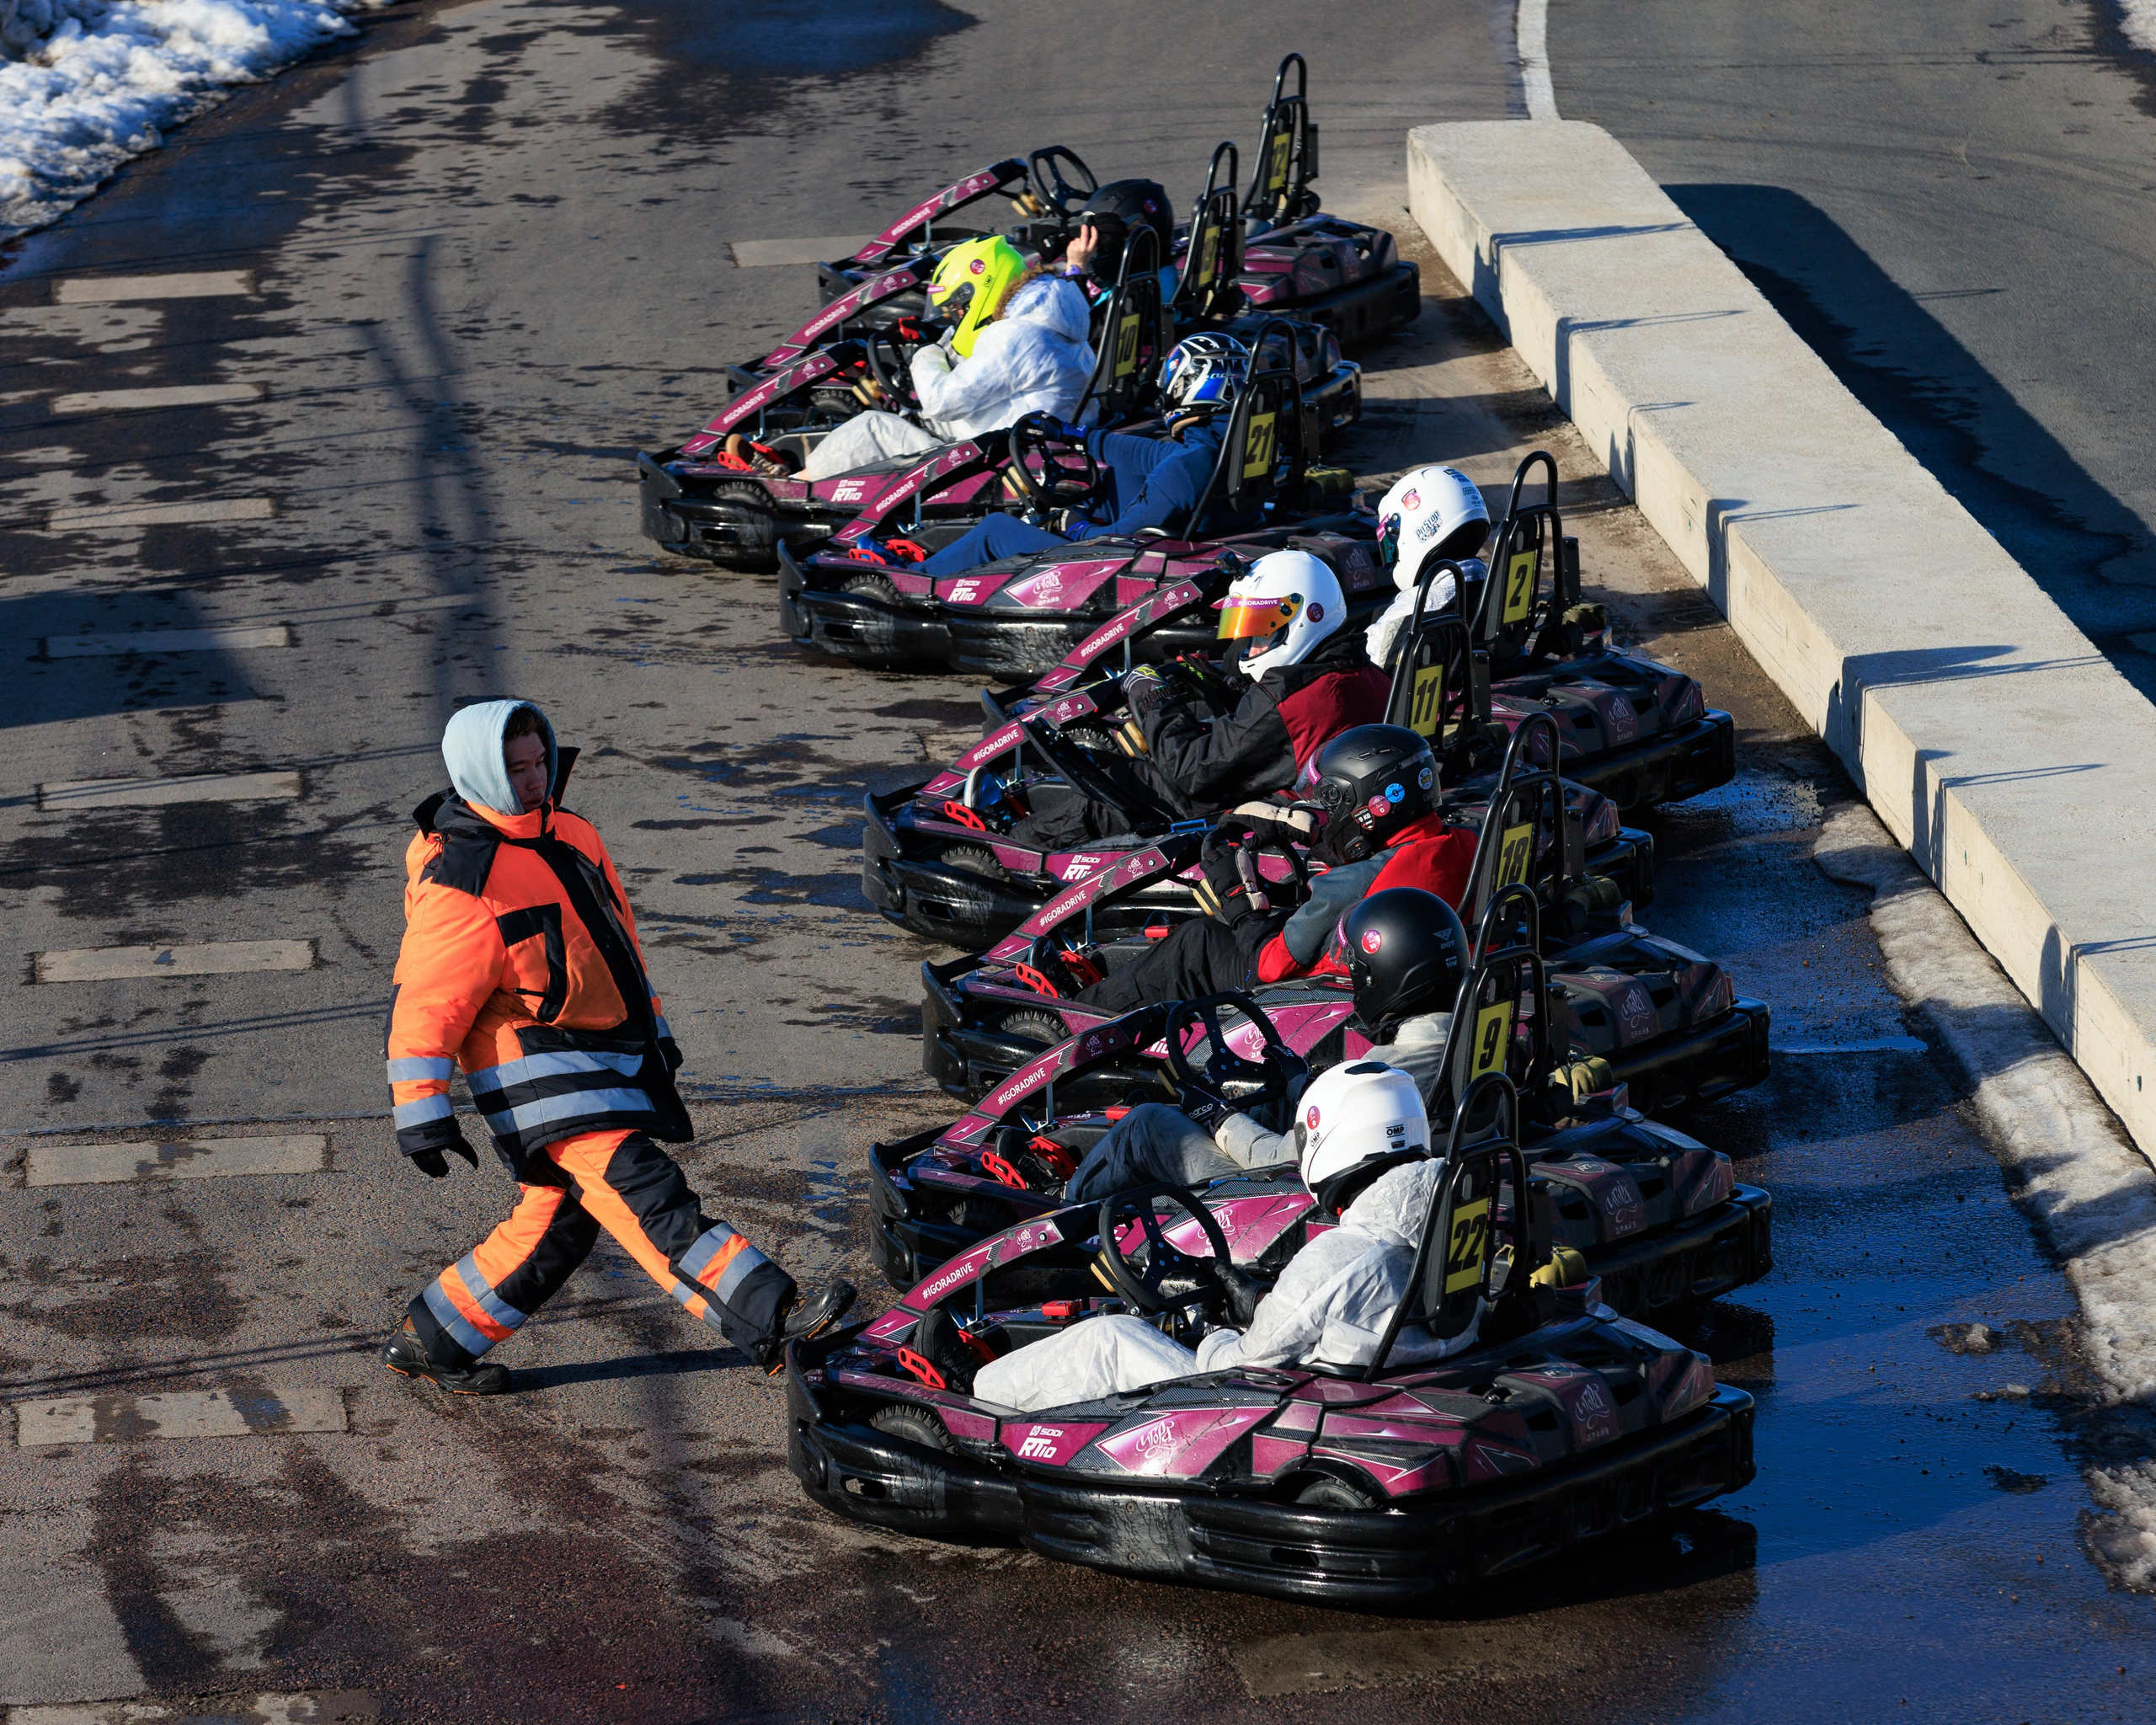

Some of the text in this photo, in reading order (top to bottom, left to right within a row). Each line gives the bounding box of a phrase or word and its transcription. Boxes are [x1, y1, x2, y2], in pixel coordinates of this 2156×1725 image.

[1117, 324, 1138, 364] 10
[1245, 422, 1273, 465] 21
[876, 479, 915, 512] #IGORADRIVE
[1508, 563, 1529, 608] 2
[1080, 622, 1125, 657] #IGORADRIVE
[1413, 676, 1438, 724] 11
[972, 729, 1019, 762] #IGORADRIVE
[1499, 836, 1529, 888] 18
[1039, 890, 1086, 927] #IGORADRIVE
[1440, 940, 1455, 949] DOT
[1478, 1017, 1502, 1071] 9
[997, 1067, 1046, 1106] #IGORADRIVE
[1187, 1103, 1214, 1119] parco
[1310, 1131, 1321, 1147] OMP
[1386, 1126, 1405, 1136] OMP
[1447, 1213, 1487, 1276] 22
[921, 1262, 974, 1300] #IGORADRIVE
[1039, 1428, 1064, 1437] SODI
